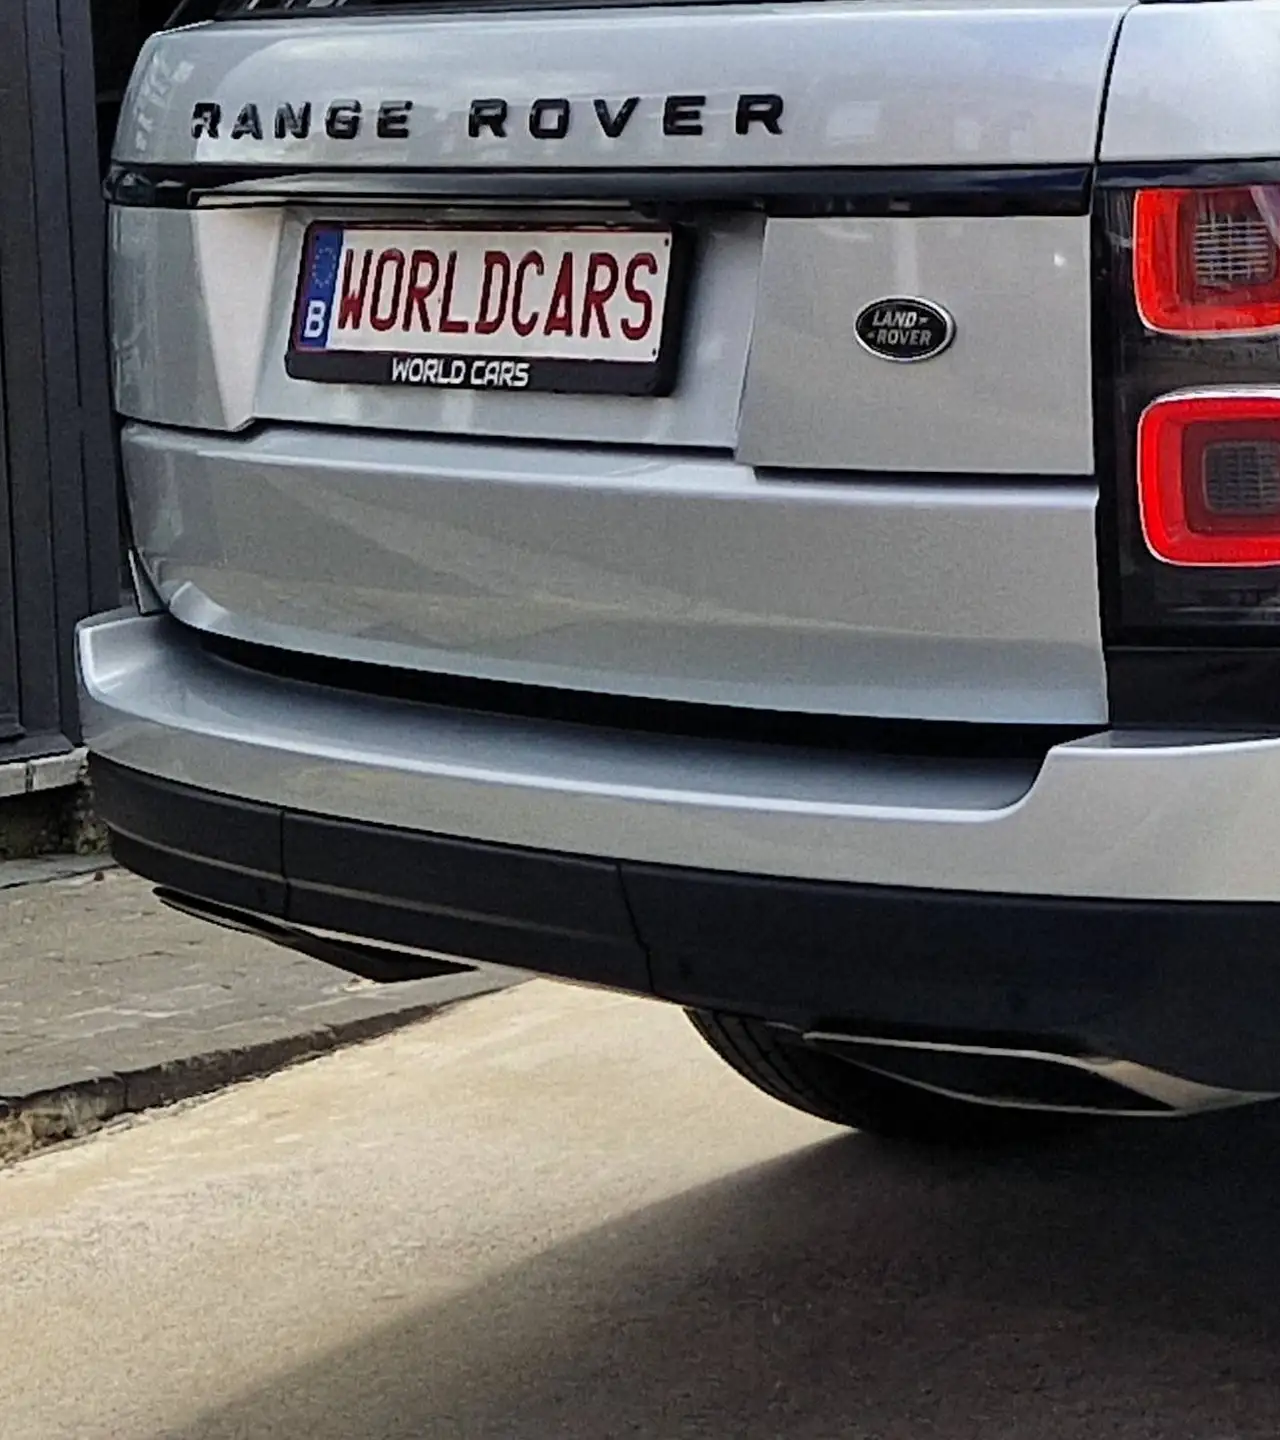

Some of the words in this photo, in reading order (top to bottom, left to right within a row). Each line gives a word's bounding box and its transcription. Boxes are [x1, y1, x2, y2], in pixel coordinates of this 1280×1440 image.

[191, 99, 413, 140] RANGE
[467, 94, 785, 139] ROVER
[337, 248, 658, 341] WORLDCARS
[304, 301, 325, 338] B
[873, 310, 917, 328] LAND
[877, 328, 932, 346] ROVER
[391, 357, 466, 385] WORLD
[471, 360, 530, 388] CARS
